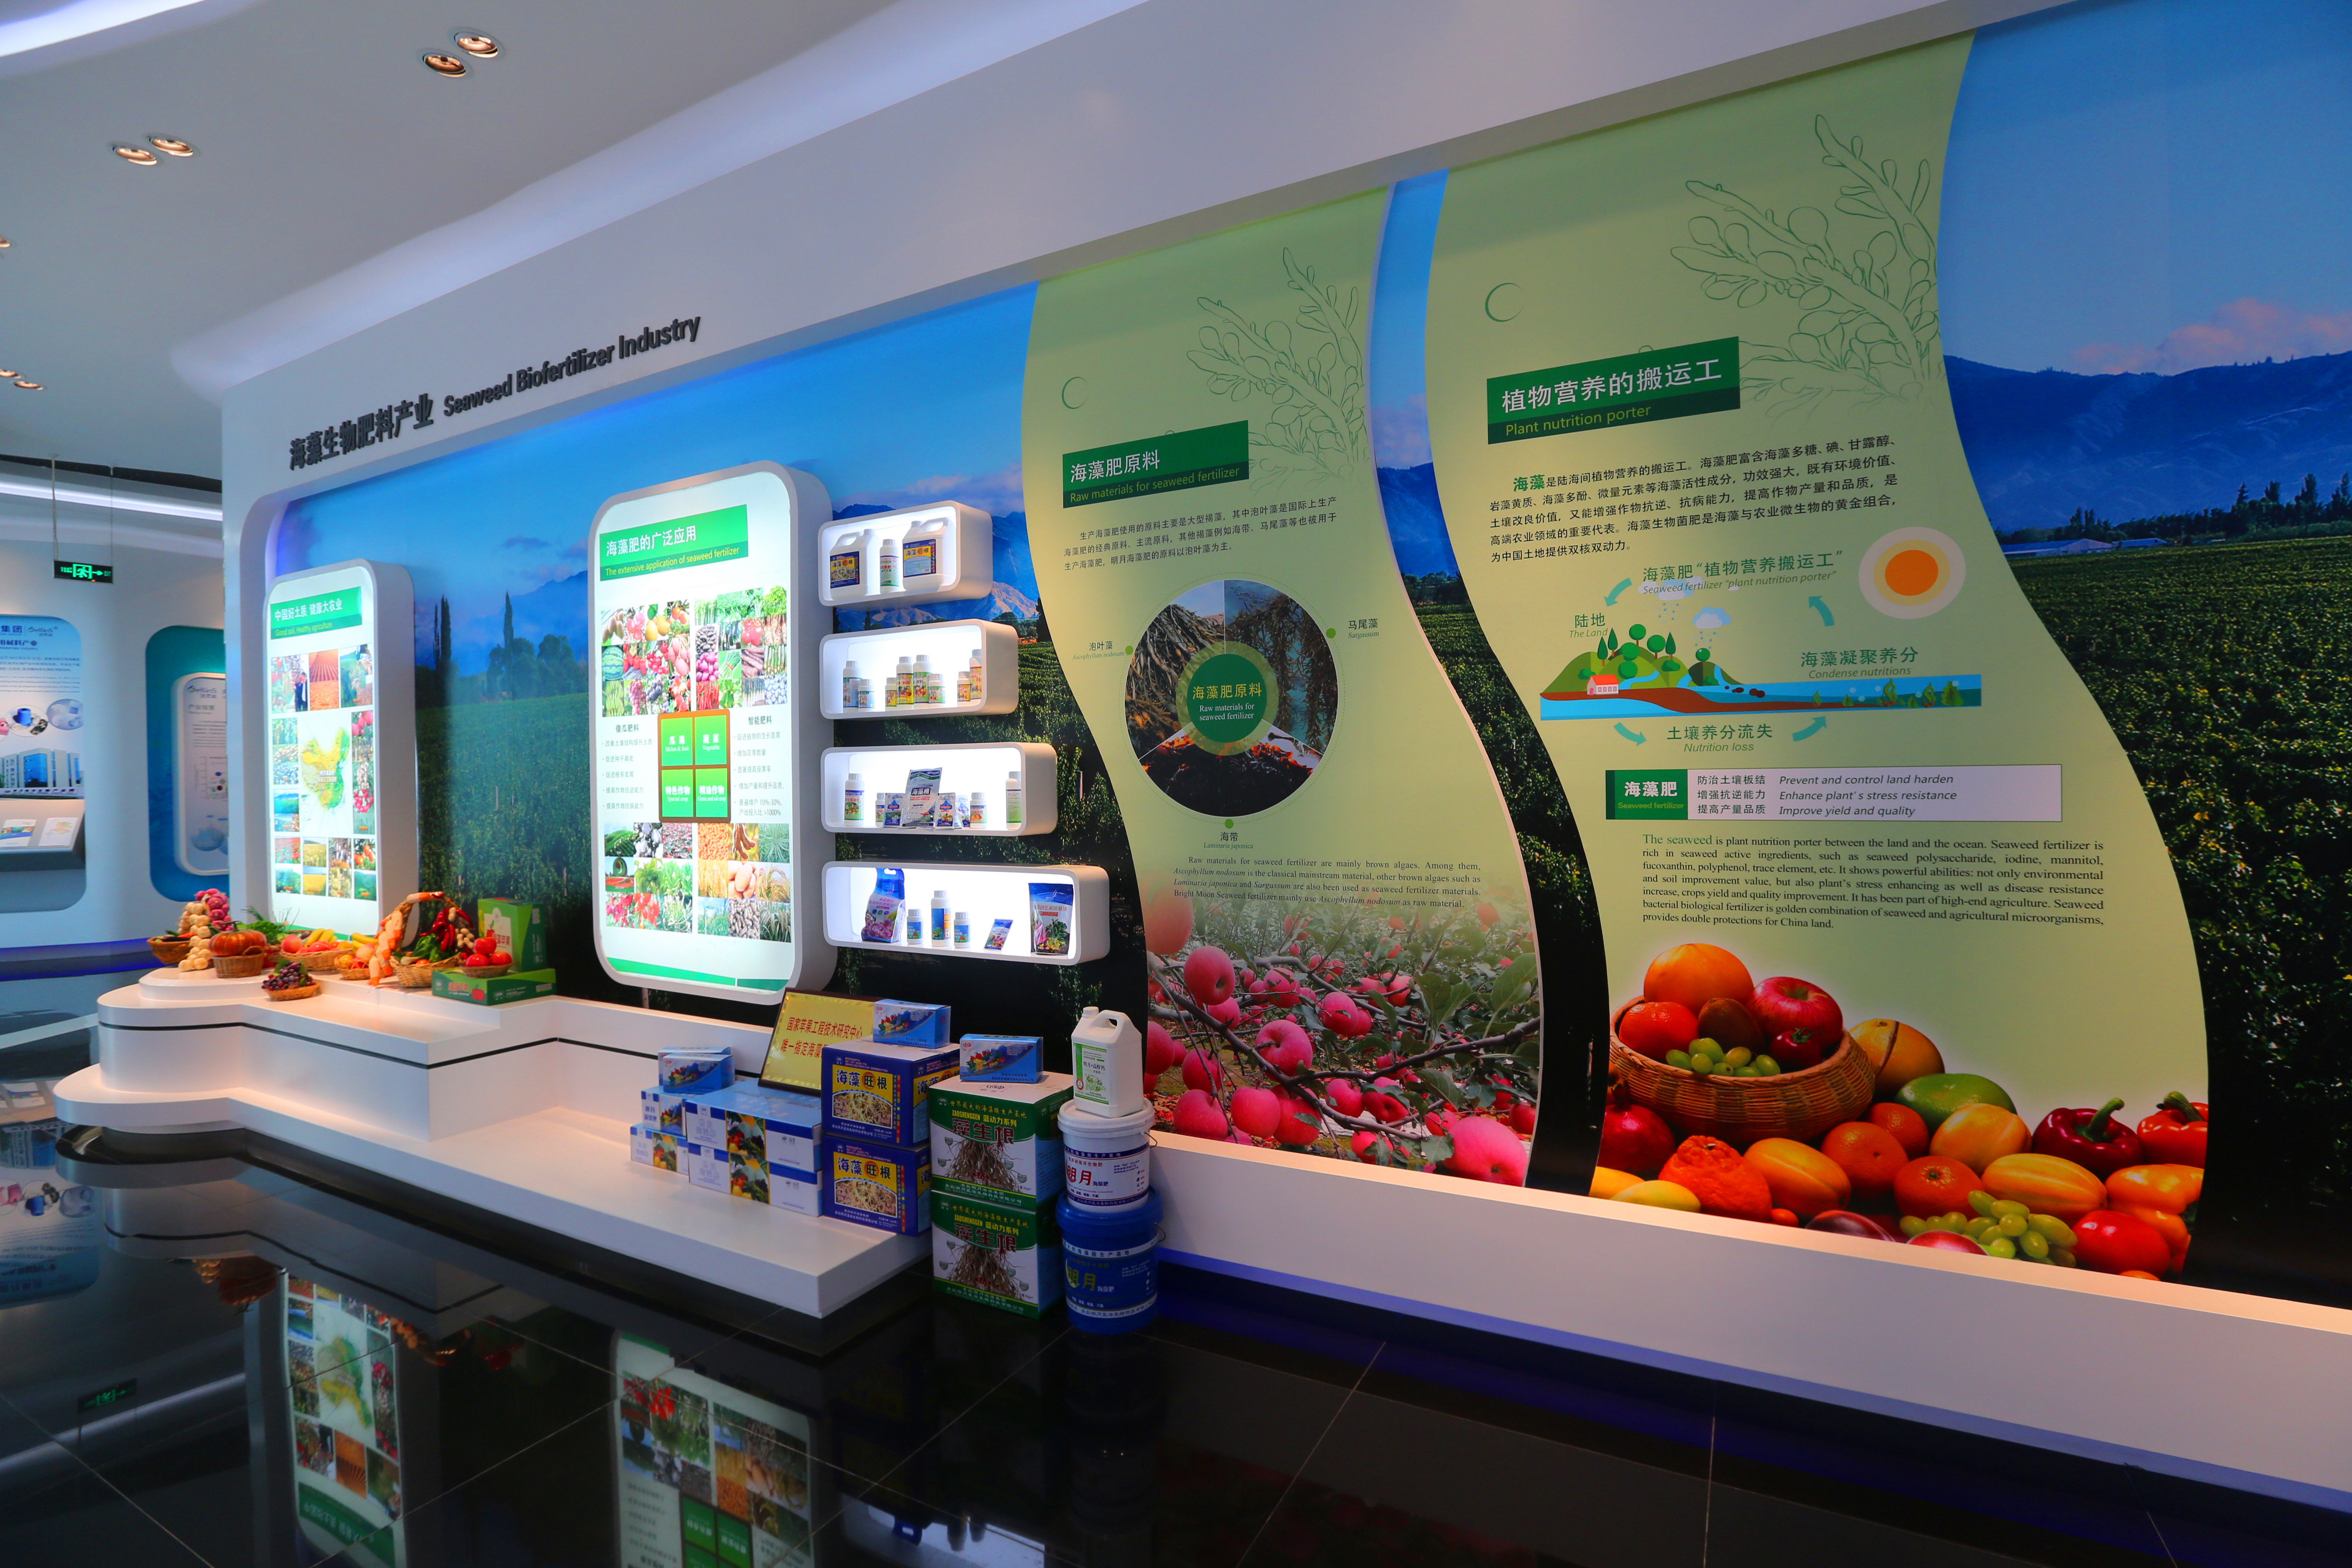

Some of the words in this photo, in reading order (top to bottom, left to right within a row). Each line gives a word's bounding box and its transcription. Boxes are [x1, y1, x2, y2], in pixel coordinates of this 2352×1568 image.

[289, 394, 433, 470] 海藻生物肥料产业
[444, 374, 512, 417] Seaweed
[516, 344, 615, 392] Biofertilizer
[618, 316, 701, 360] Industry
[1502, 359, 1722, 413] 植物营养的搬运工
[1506, 422, 1539, 436] Plant
[1544, 414, 1601, 430] nutrition
[1607, 406, 1651, 424] porter
[1070, 449, 1160, 483] 海藻肥原料
[1071, 493, 1088, 502] Raw
[1092, 483, 1133, 499] materials
[1136, 481, 1149, 490] for
[1153, 473, 1194, 488] seaweed
[1198, 467, 1239, 481] fertilizer
[606, 525, 697, 557] 海藻肥的广泛应用
[606, 568, 616, 576] The
[618, 563, 644, 574] extensive
[646, 558, 677, 571] application
[679, 555, 685, 564] of
[687, 550, 712, 562] seaweed
[714, 546, 739, 557] fertilizer
[1643, 550, 1842, 582] 海藻肥“植物营养搬运工”
[1643, 584, 1683, 594] Seaweed
[1685, 581, 1722, 591] fertilizer
[1756, 575, 1798, 585] nutrition
[275, 605, 307, 621] 中国好土质
[310, 598, 343, 616] 健康大农业
[1348, 618, 1379, 630] 马尾藻
[1575, 612, 1606, 629] 陆地
[1569, 630, 1584, 638] The
[1587, 628, 1608, 637] Land
[1089, 641, 1113, 651] 泡叶藻
[1801, 647, 1918, 667] 海藻凝聚养分
[1809, 668, 1858, 679] Condense
[1861, 666, 1911, 677] nutritions
[1193, 682, 1262, 700] 海藻肥原料
[615, 724, 639, 733] 傻瓜肥料
[748, 715, 772, 725] 智能肥料
[669, 735, 685, 744] 瓜果
[703, 734, 719, 744] 蔬菜
[737, 731, 780, 740] 促进植物的生长发育
[1667, 723, 1773, 741] 土壤养分流失
[1684, 742, 1729, 752] Nutrition
[1732, 742, 1754, 751] loss
[1697, 775, 1765, 785] 防治土壤板结
[1780, 776, 1818, 784] Prevent
[1822, 775, 1841, 784] and
[1845, 775, 1883, 784] control
[1886, 775, 1910, 784] land
[1914, 775, 1953, 784] harden
[666, 786, 690, 795] 特色作物
[699, 785, 724, 795] 粮油作物
[1624, 781, 1678, 797] 海藻肥
[1697, 790, 1765, 800] 增强抗逆能力
[1780, 791, 1822, 800] Enhance
[1902, 791, 1956, 800] resistance
[1698, 804, 1765, 814] 提高产量品质
[1779, 806, 1822, 816] Improve
[1826, 806, 1851, 817] yield
[1854, 806, 1874, 815] and
[1878, 806, 1915, 817] quality
[1221, 832, 1238, 842] 海带
[1336, 860, 1361, 869] mainly
[1394, 862, 1419, 870] algaes.
[1425, 862, 1453, 871] Among
[1459, 862, 1481, 871] them,
[786, 1017, 862, 1039] 国家苹果工程技术研究中心
[781, 1039, 828, 1058] 唯一指定海藻
[836, 1069, 887, 1090] 海藻旺根
[918, 1071, 960, 1095] 海藻
[952, 1110, 980, 1120] ZAOSHENGGEN
[983, 1115, 1017, 1127] 蓝动力系列
[951, 1118, 1014, 1145] 藻生根
[838, 1157, 891, 1179] 海藻旺根
[1067, 1165, 1092, 1186] 明月
[955, 1214, 982, 1227] ZAOSHENGGEN
[985, 1221, 1019, 1236] 蓝动力系列
[954, 1222, 1016, 1253] 藻生根
